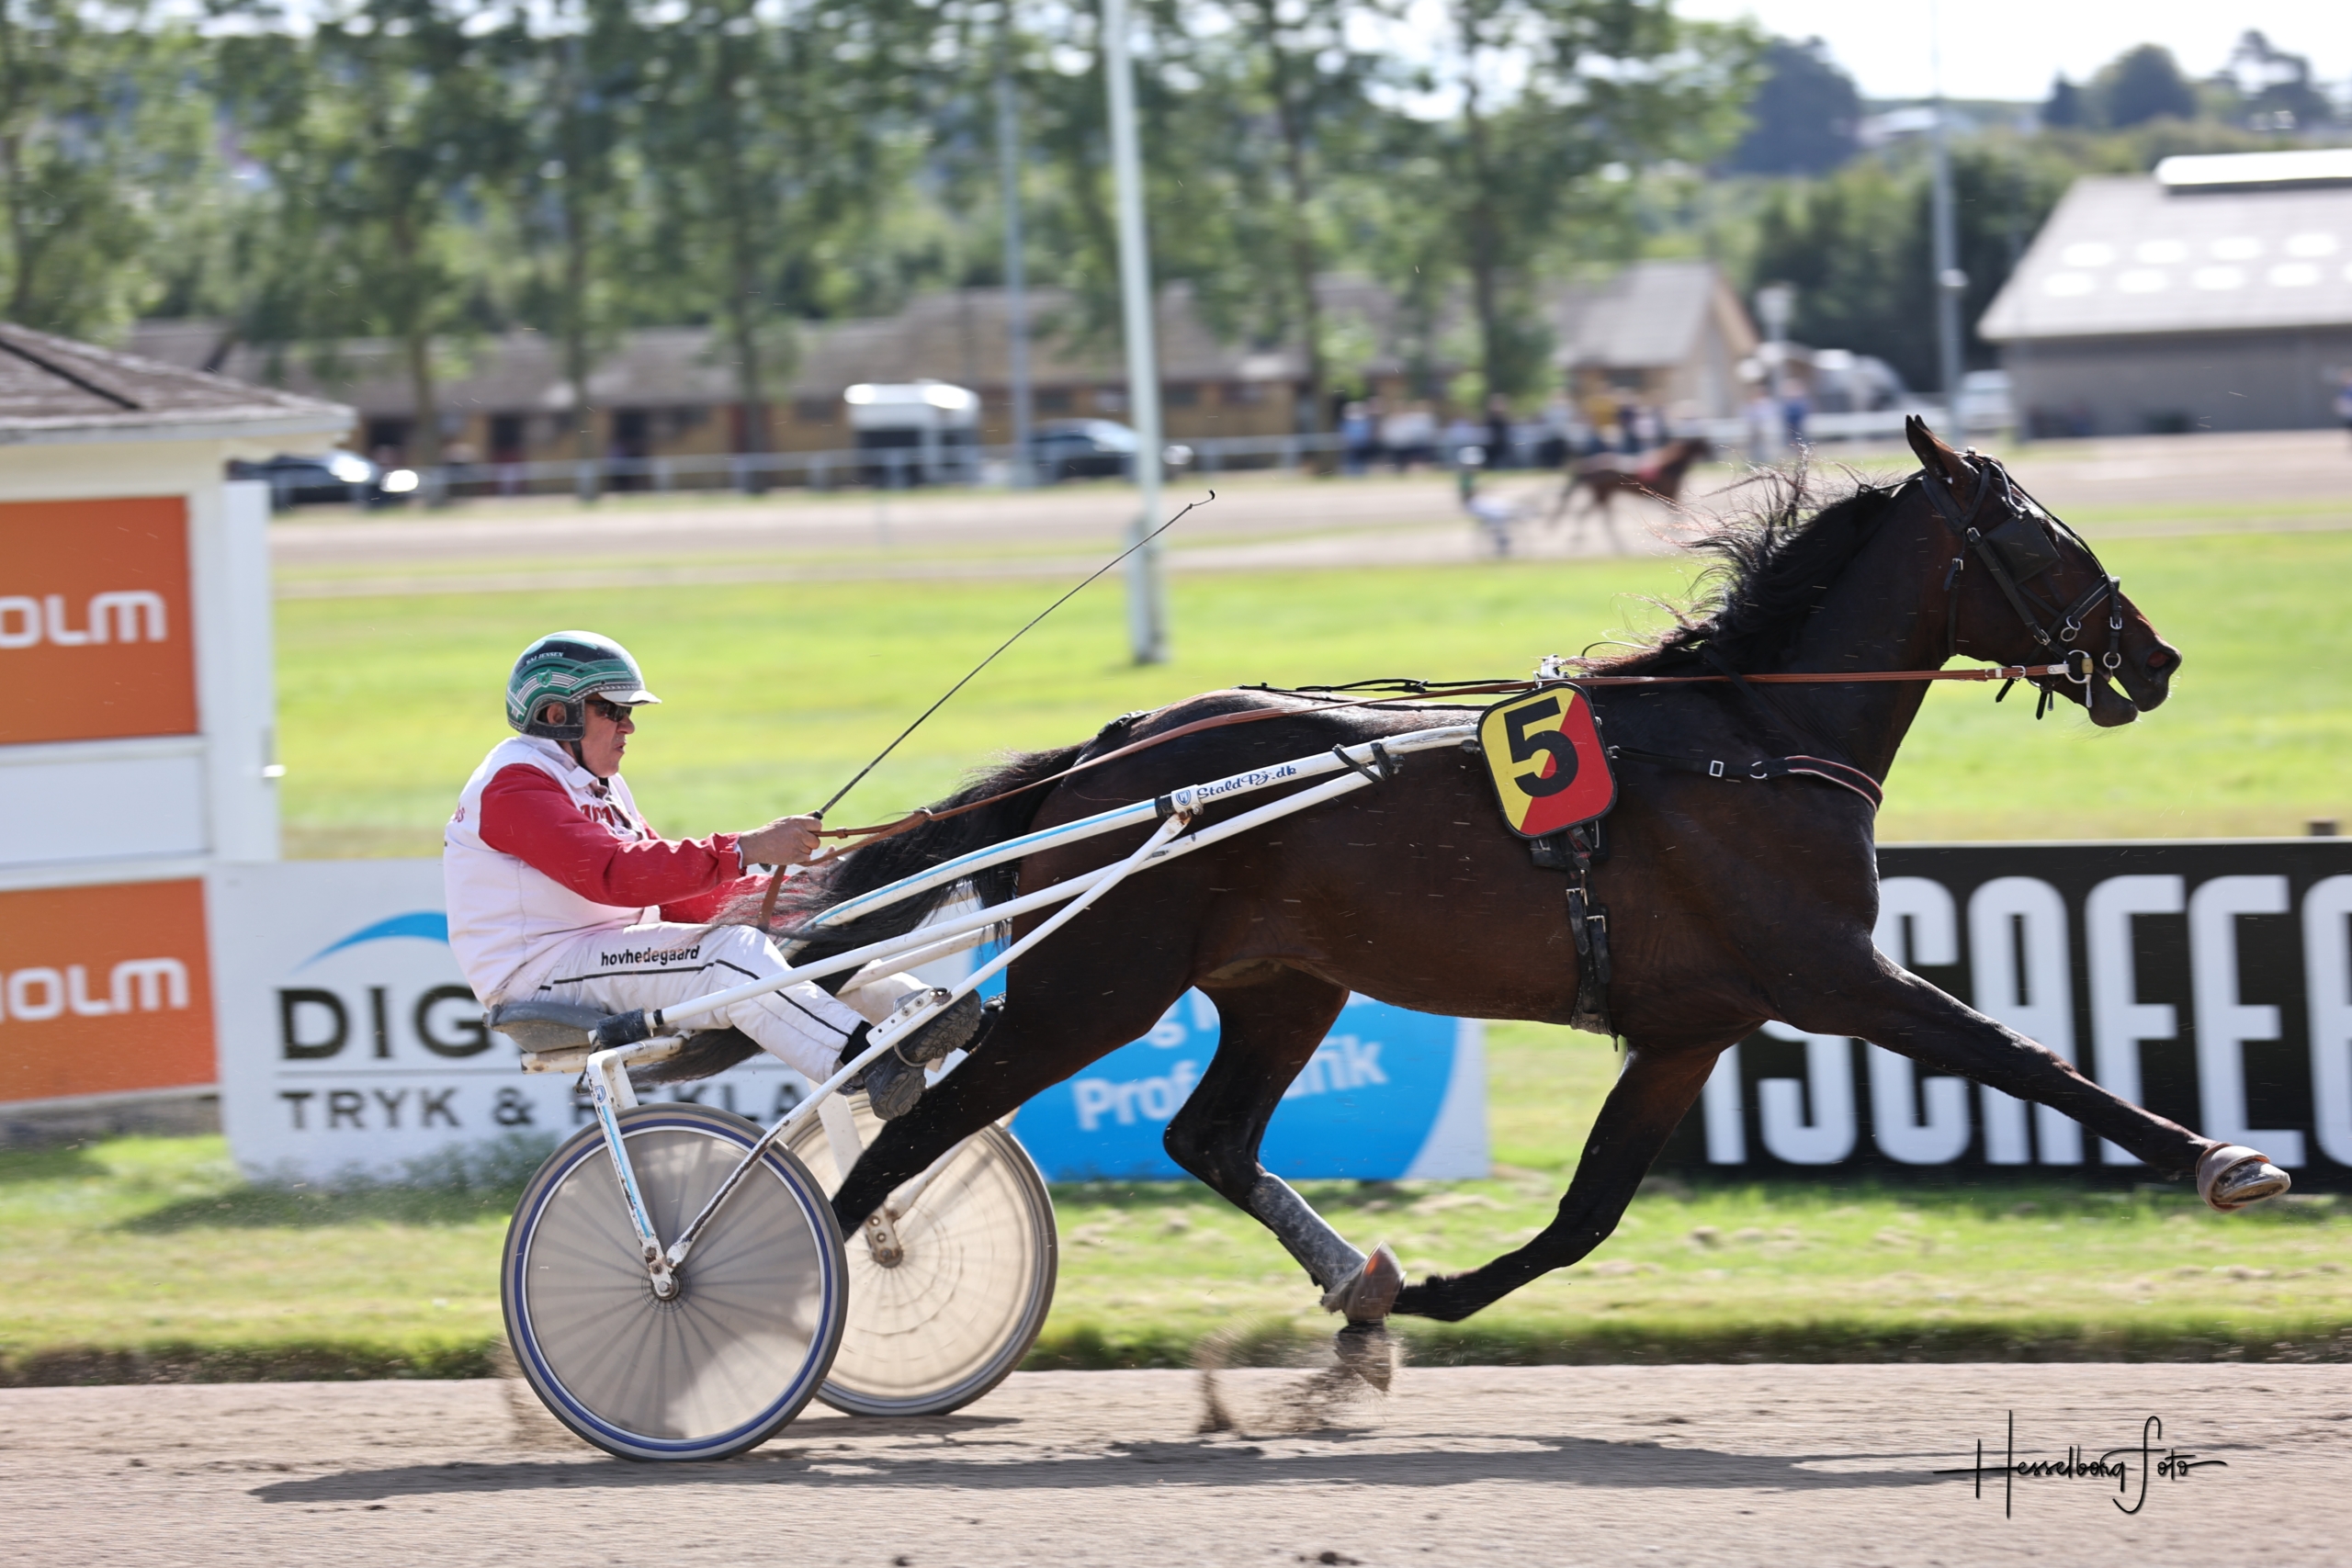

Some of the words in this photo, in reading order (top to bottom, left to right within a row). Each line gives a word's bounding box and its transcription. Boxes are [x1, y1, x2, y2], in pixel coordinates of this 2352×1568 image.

[538, 651, 564, 660] JENSEN
[1503, 695, 1579, 798] 5
[601, 945, 700, 966] hovhedegaard
[0, 957, 189, 1025] OLM
[277, 984, 526, 1059] DIG
[278, 1089, 460, 1129] TRYK
[492, 1088, 534, 1125] &
